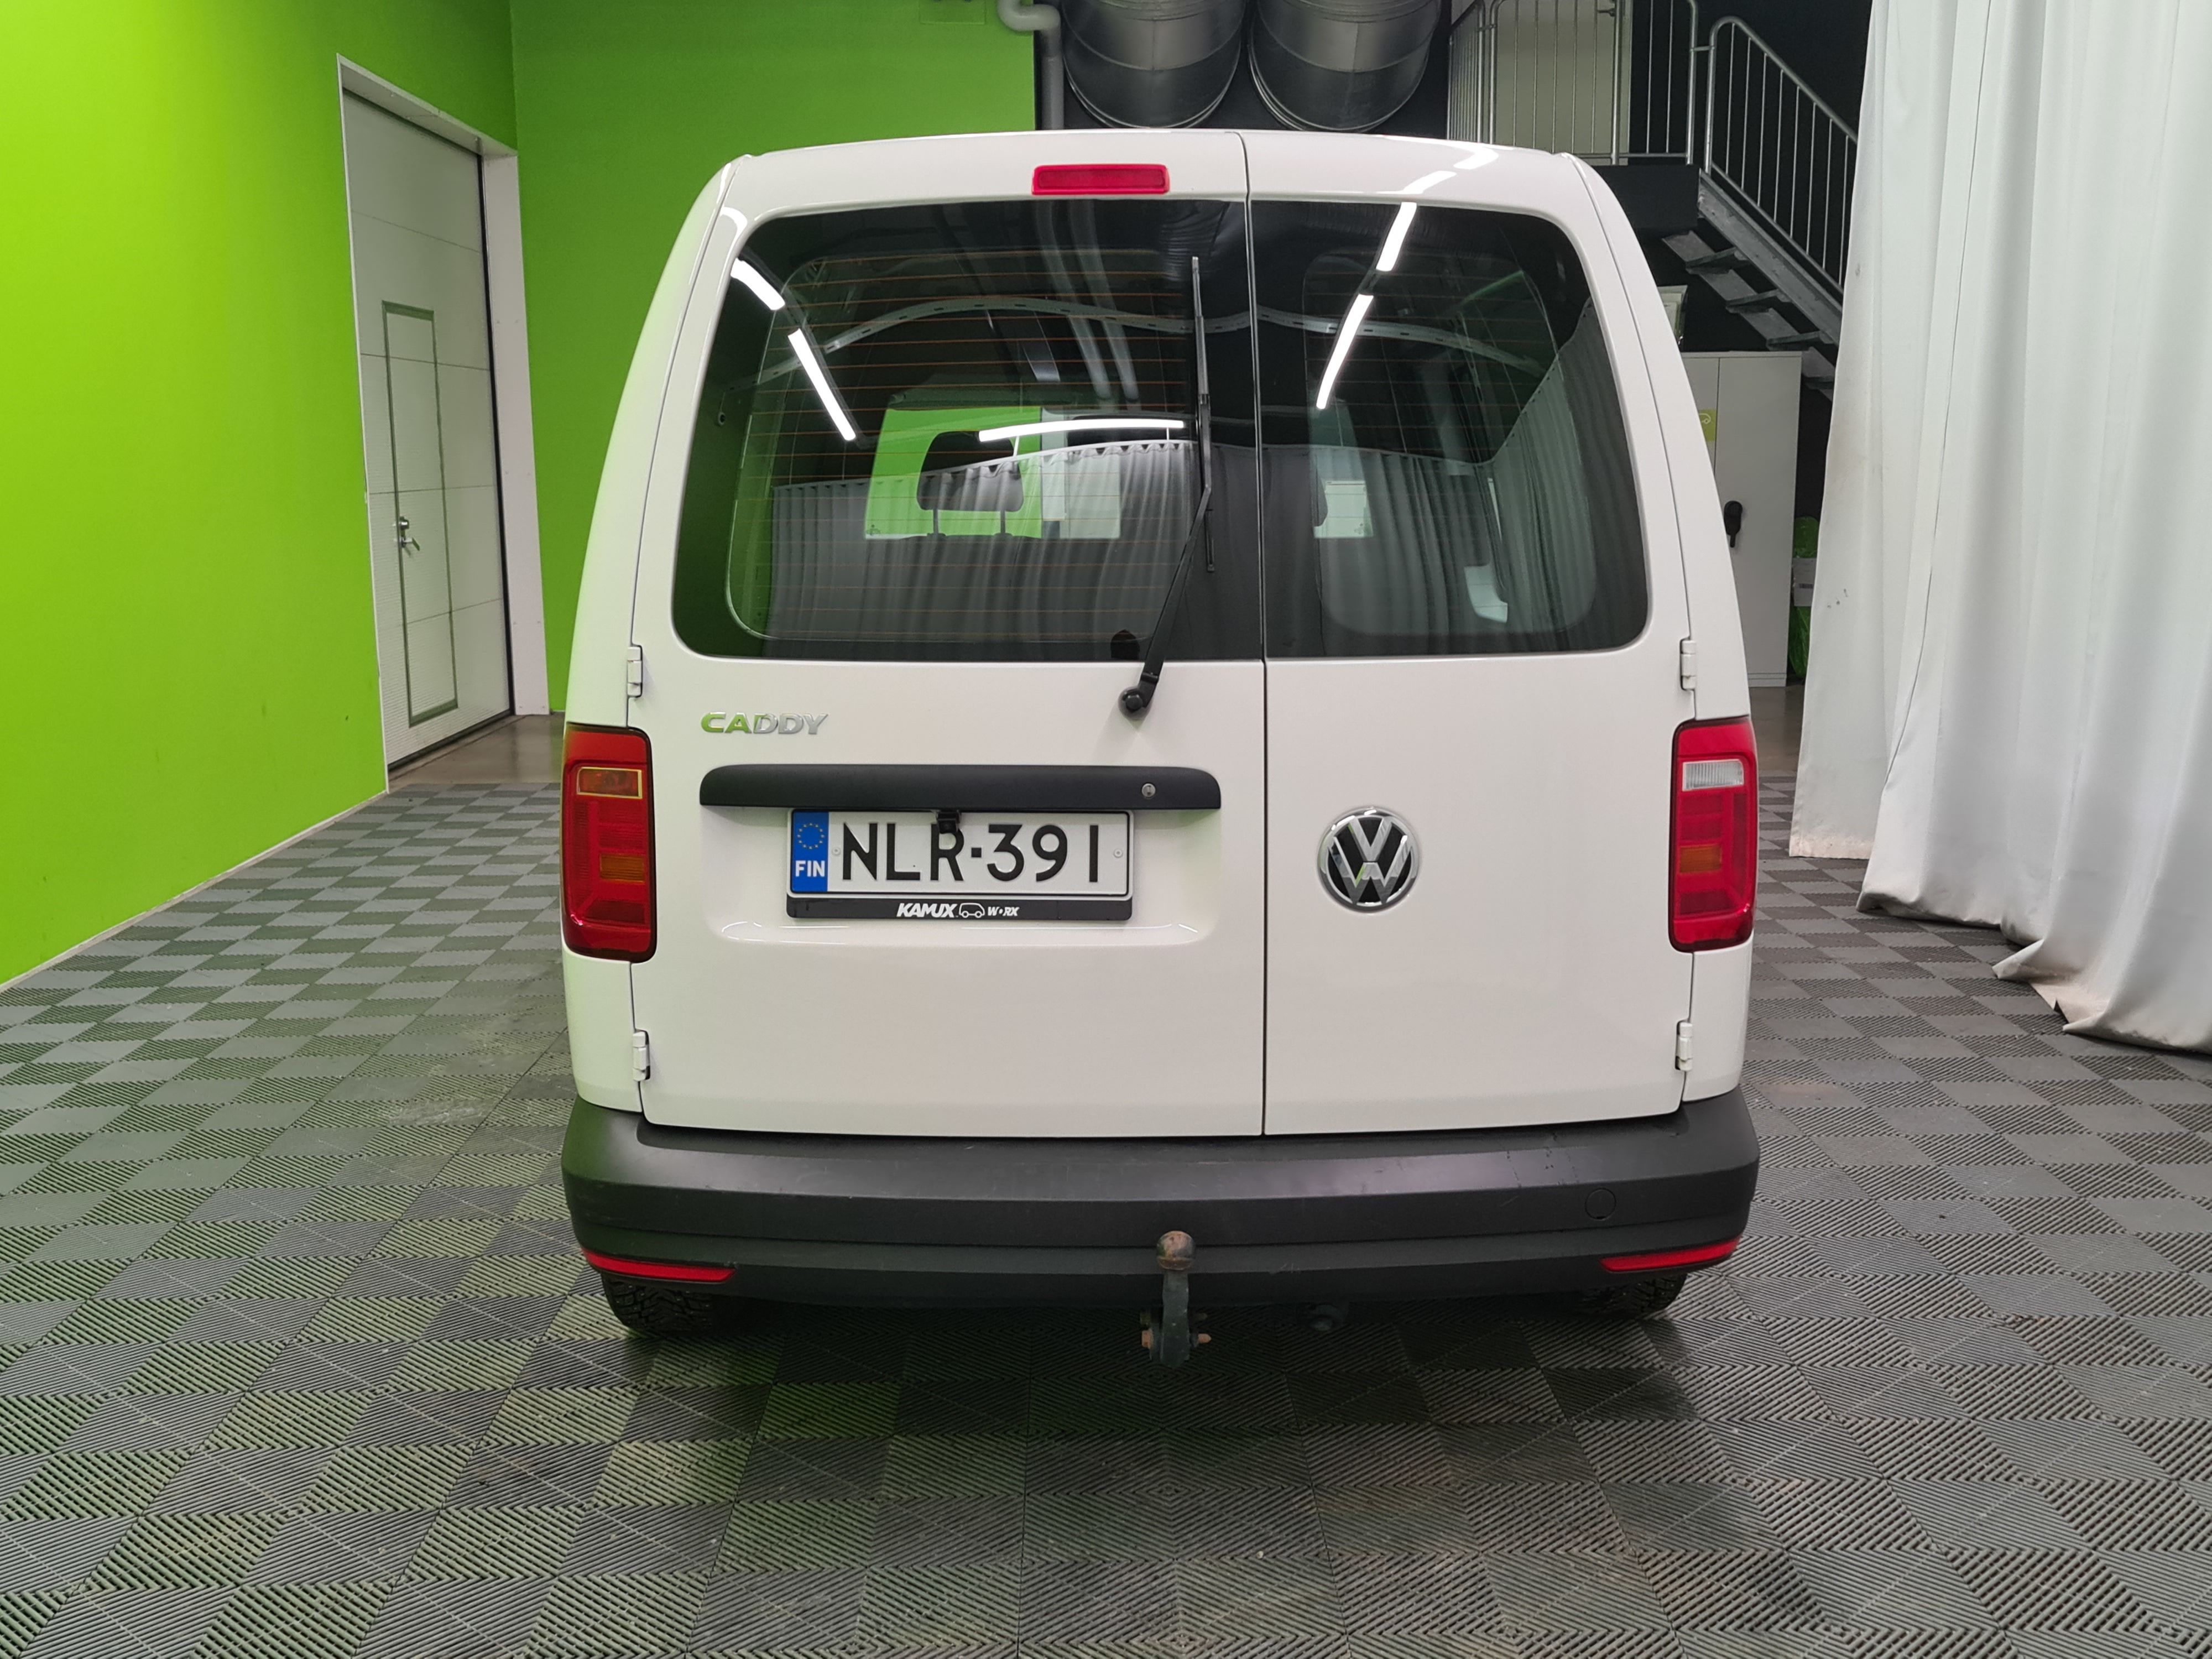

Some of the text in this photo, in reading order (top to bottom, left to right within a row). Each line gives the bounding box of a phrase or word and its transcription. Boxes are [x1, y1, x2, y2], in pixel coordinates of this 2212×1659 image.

[701, 711, 828, 735] CADDY
[842, 822, 1099, 883] NLR-391
[795, 860, 825, 877] FIN
[896, 902, 957, 918] KAMUX
